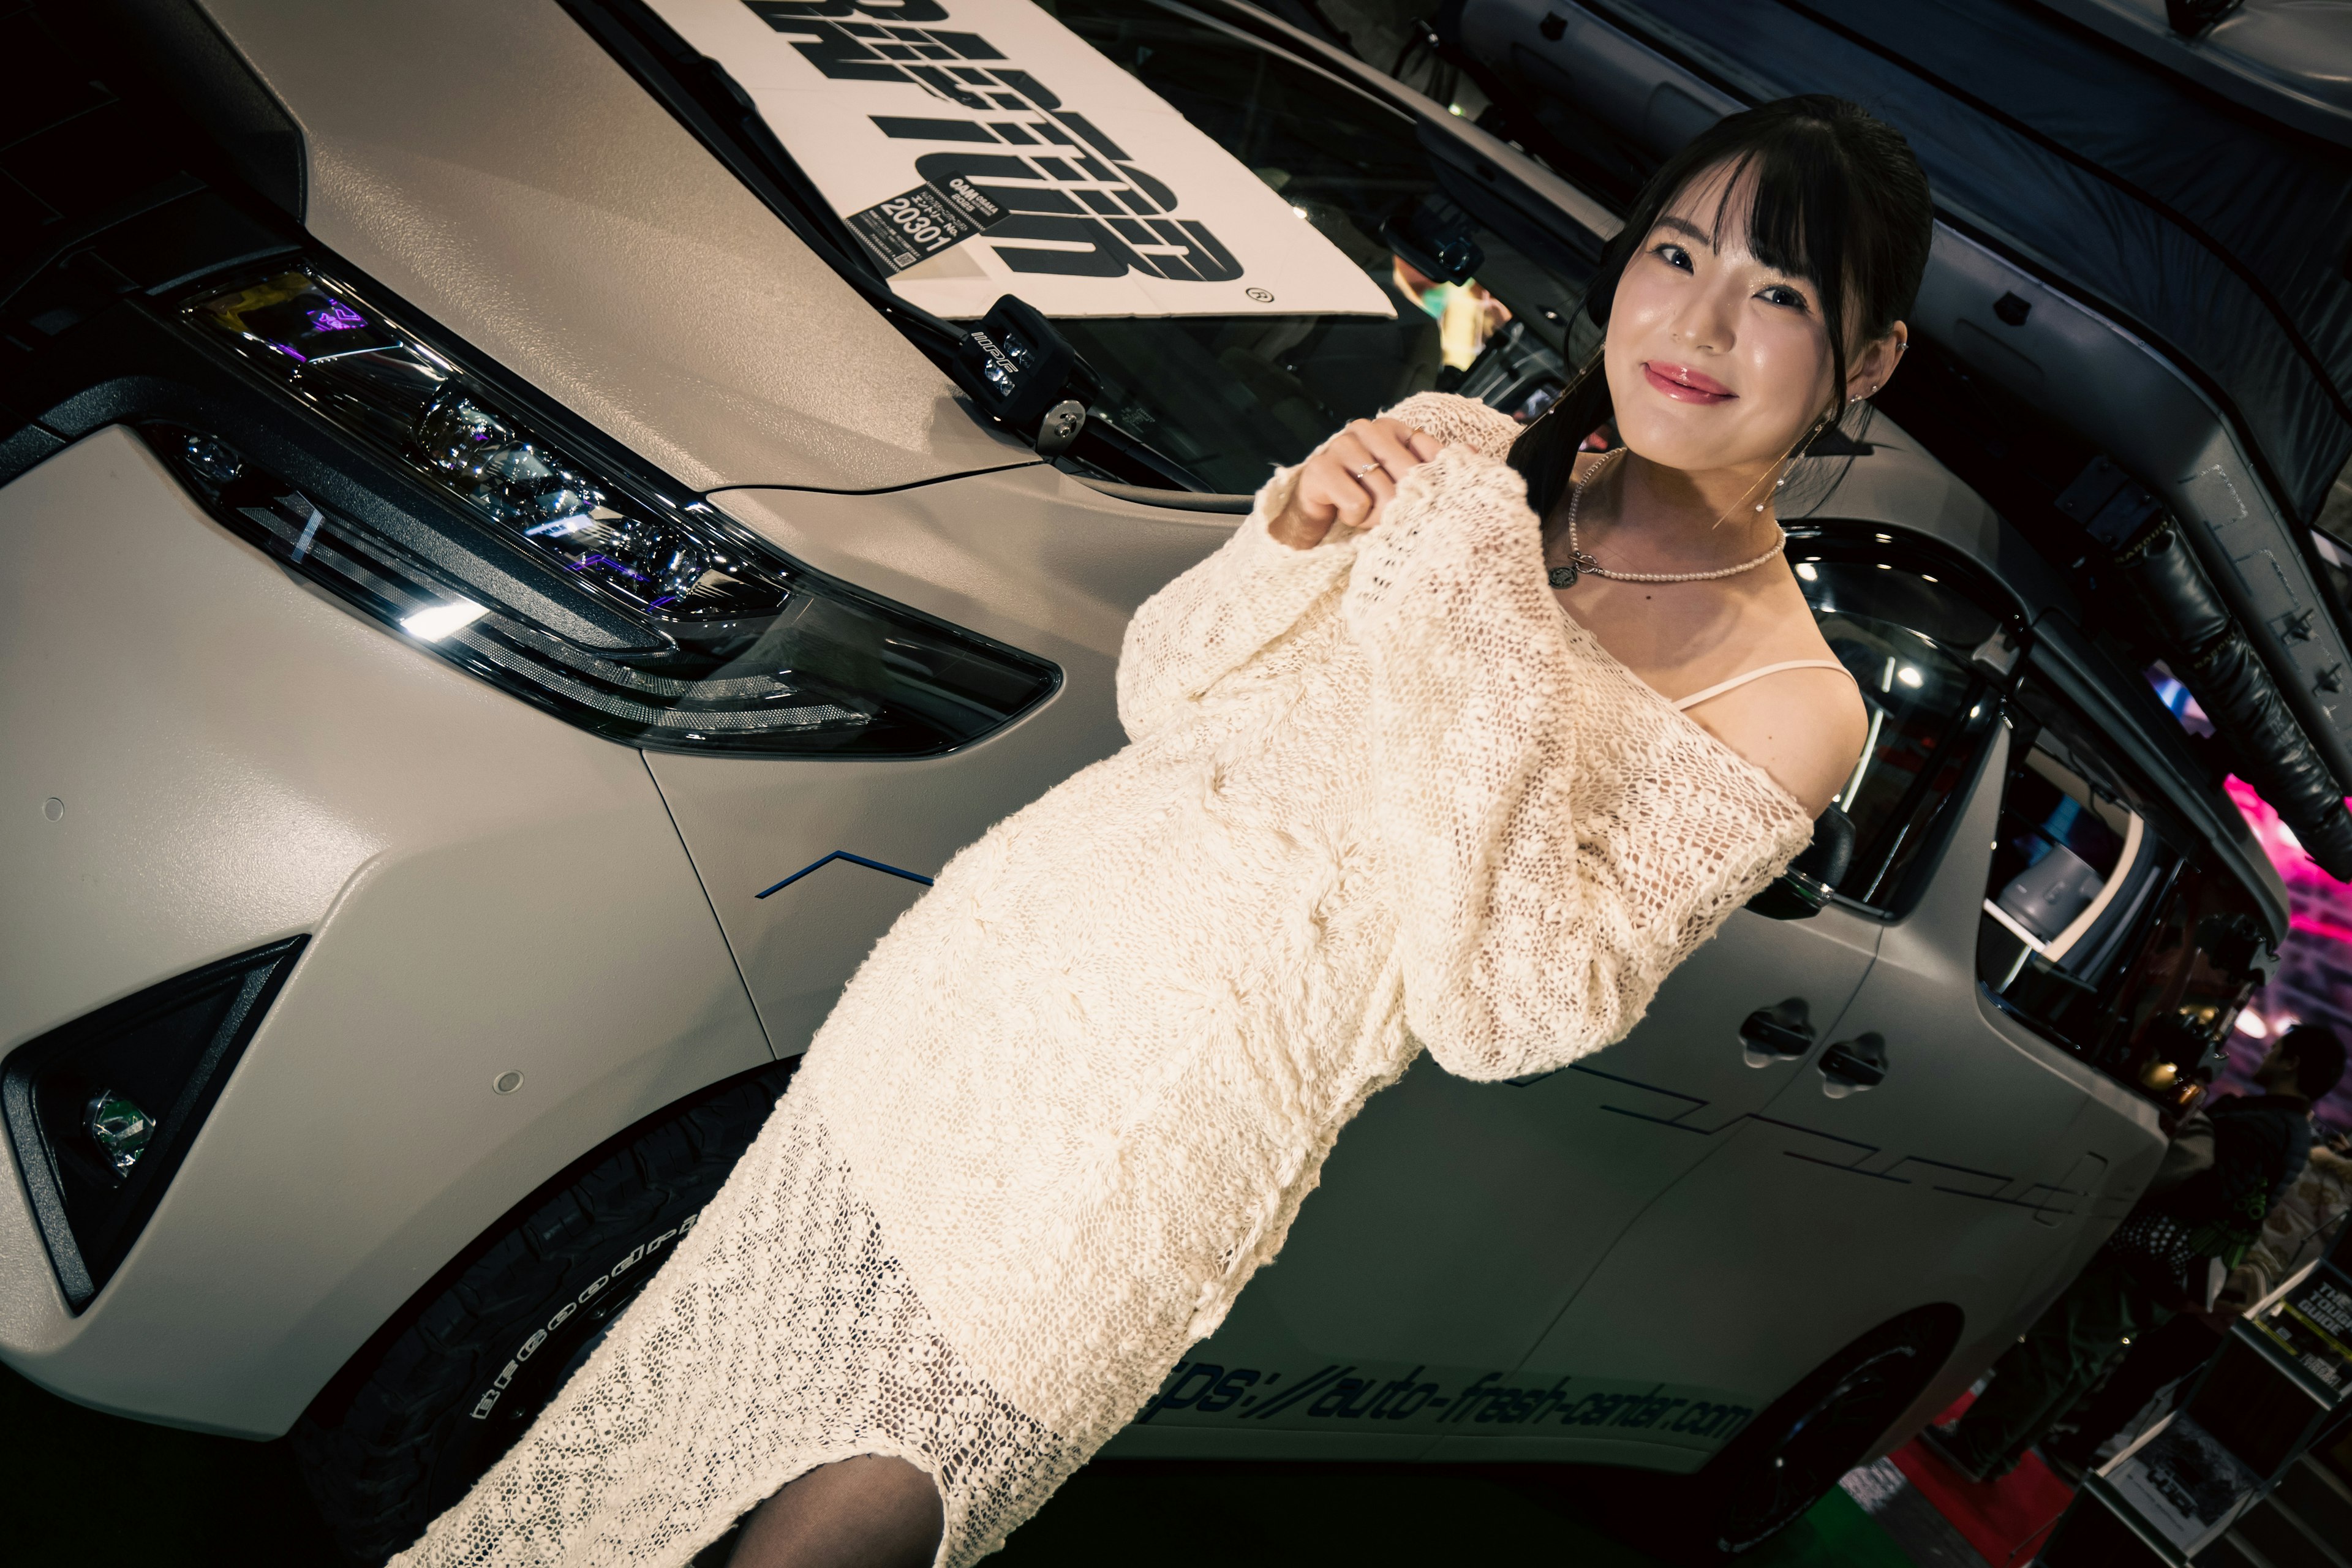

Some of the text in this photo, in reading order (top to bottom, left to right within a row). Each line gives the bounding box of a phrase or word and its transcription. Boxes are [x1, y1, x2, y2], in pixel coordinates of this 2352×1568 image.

[949, 178, 980, 202] OAM
[951, 193, 976, 213] 2025
[975, 195, 999, 214] OSAKA
[880, 197, 952, 252] 20301
[911, 195, 945, 224] エントリー
[943, 222, 958, 238] No.
[2297, 1297, 2345, 1337] GUIDE
